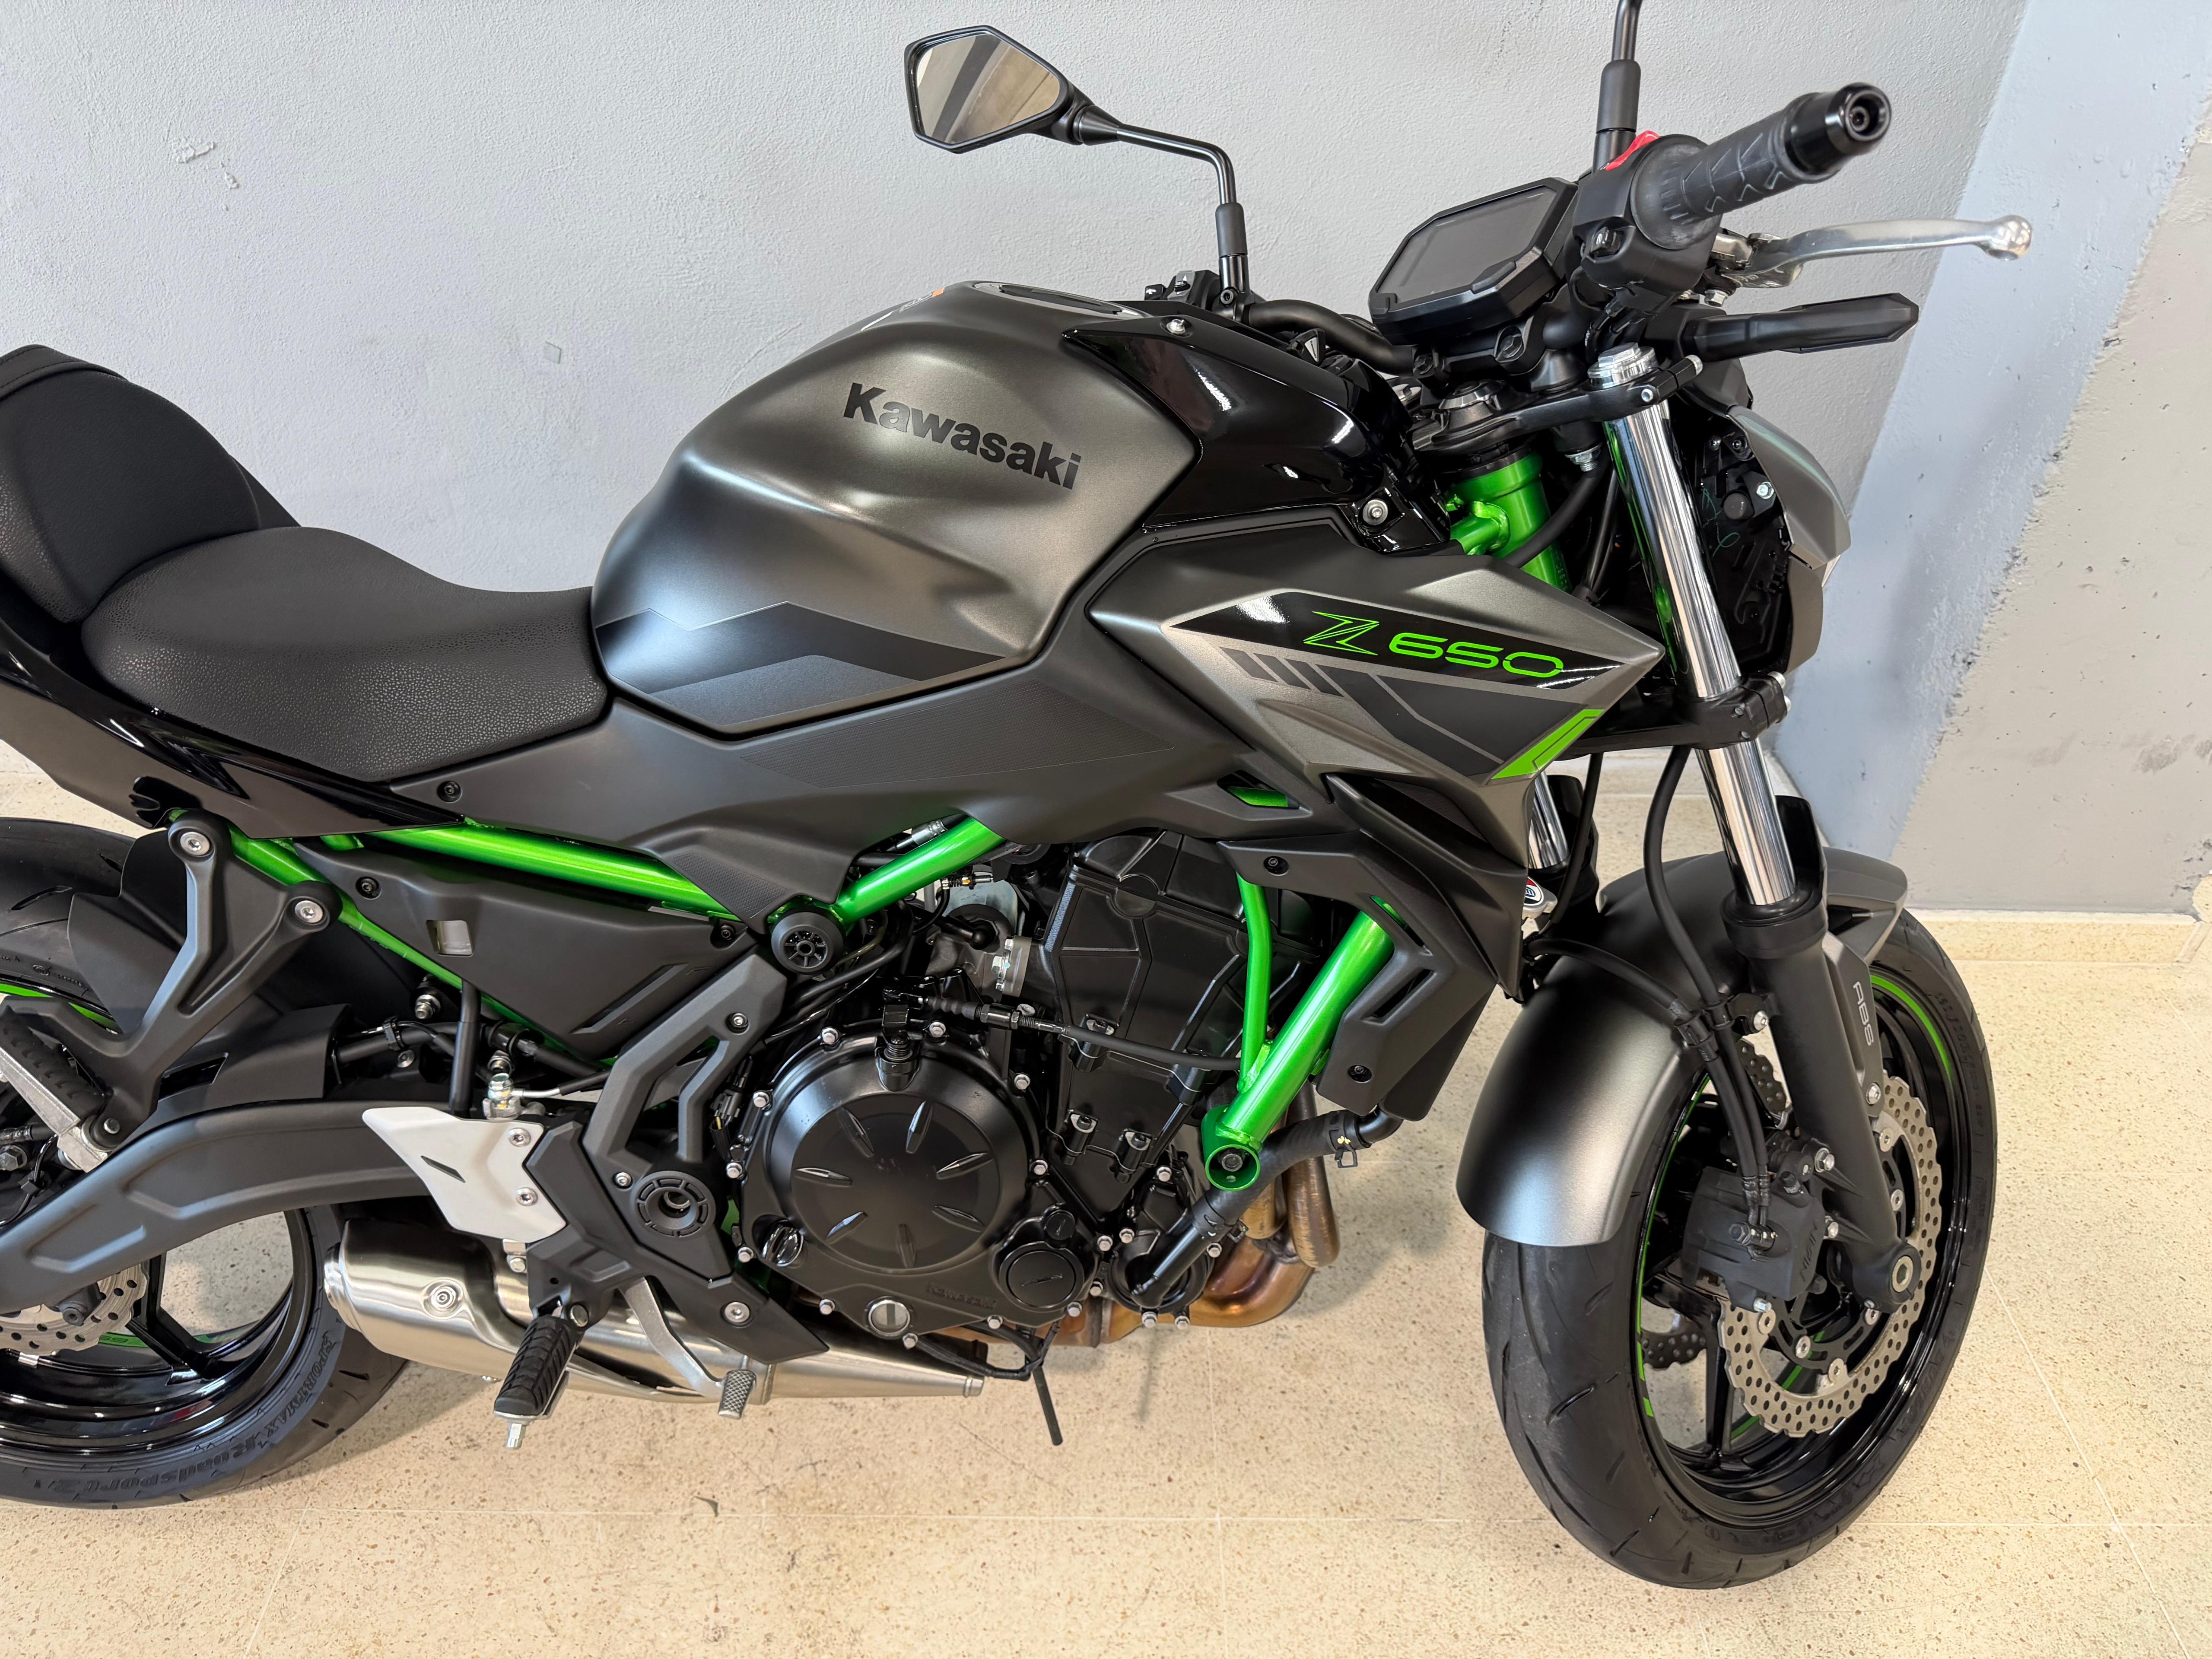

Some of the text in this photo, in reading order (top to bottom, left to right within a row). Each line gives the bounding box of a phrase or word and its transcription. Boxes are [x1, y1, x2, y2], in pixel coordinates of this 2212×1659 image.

[843, 382, 1082, 490] Kawasaki
[1303, 610, 1564, 678] Z 650
[1853, 981, 1874, 1046] ABS
[264, 1331, 338, 1438] SPORTMAX
